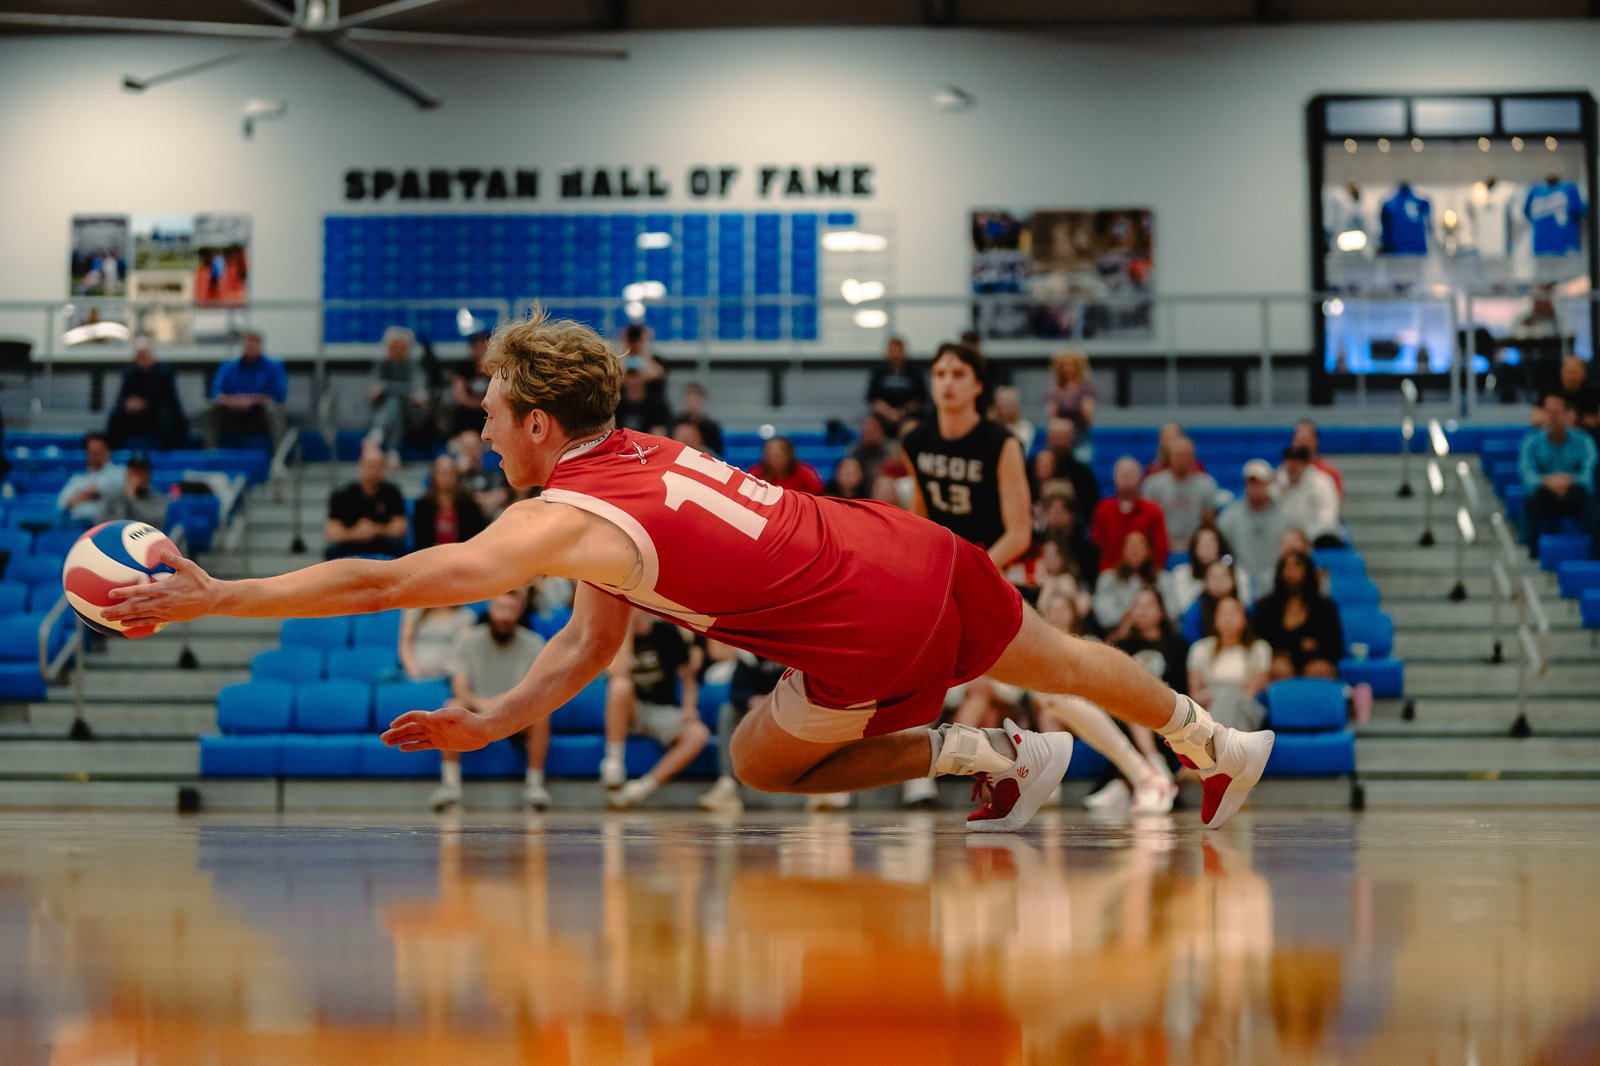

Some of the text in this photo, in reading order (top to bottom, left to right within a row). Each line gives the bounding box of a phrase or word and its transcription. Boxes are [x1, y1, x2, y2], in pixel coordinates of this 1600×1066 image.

[345, 168, 874, 199] SPARTAN HALL OF FAME
[916, 451, 983, 483] MSOE
[661, 446, 784, 541] 15
[926, 480, 972, 515] 13
